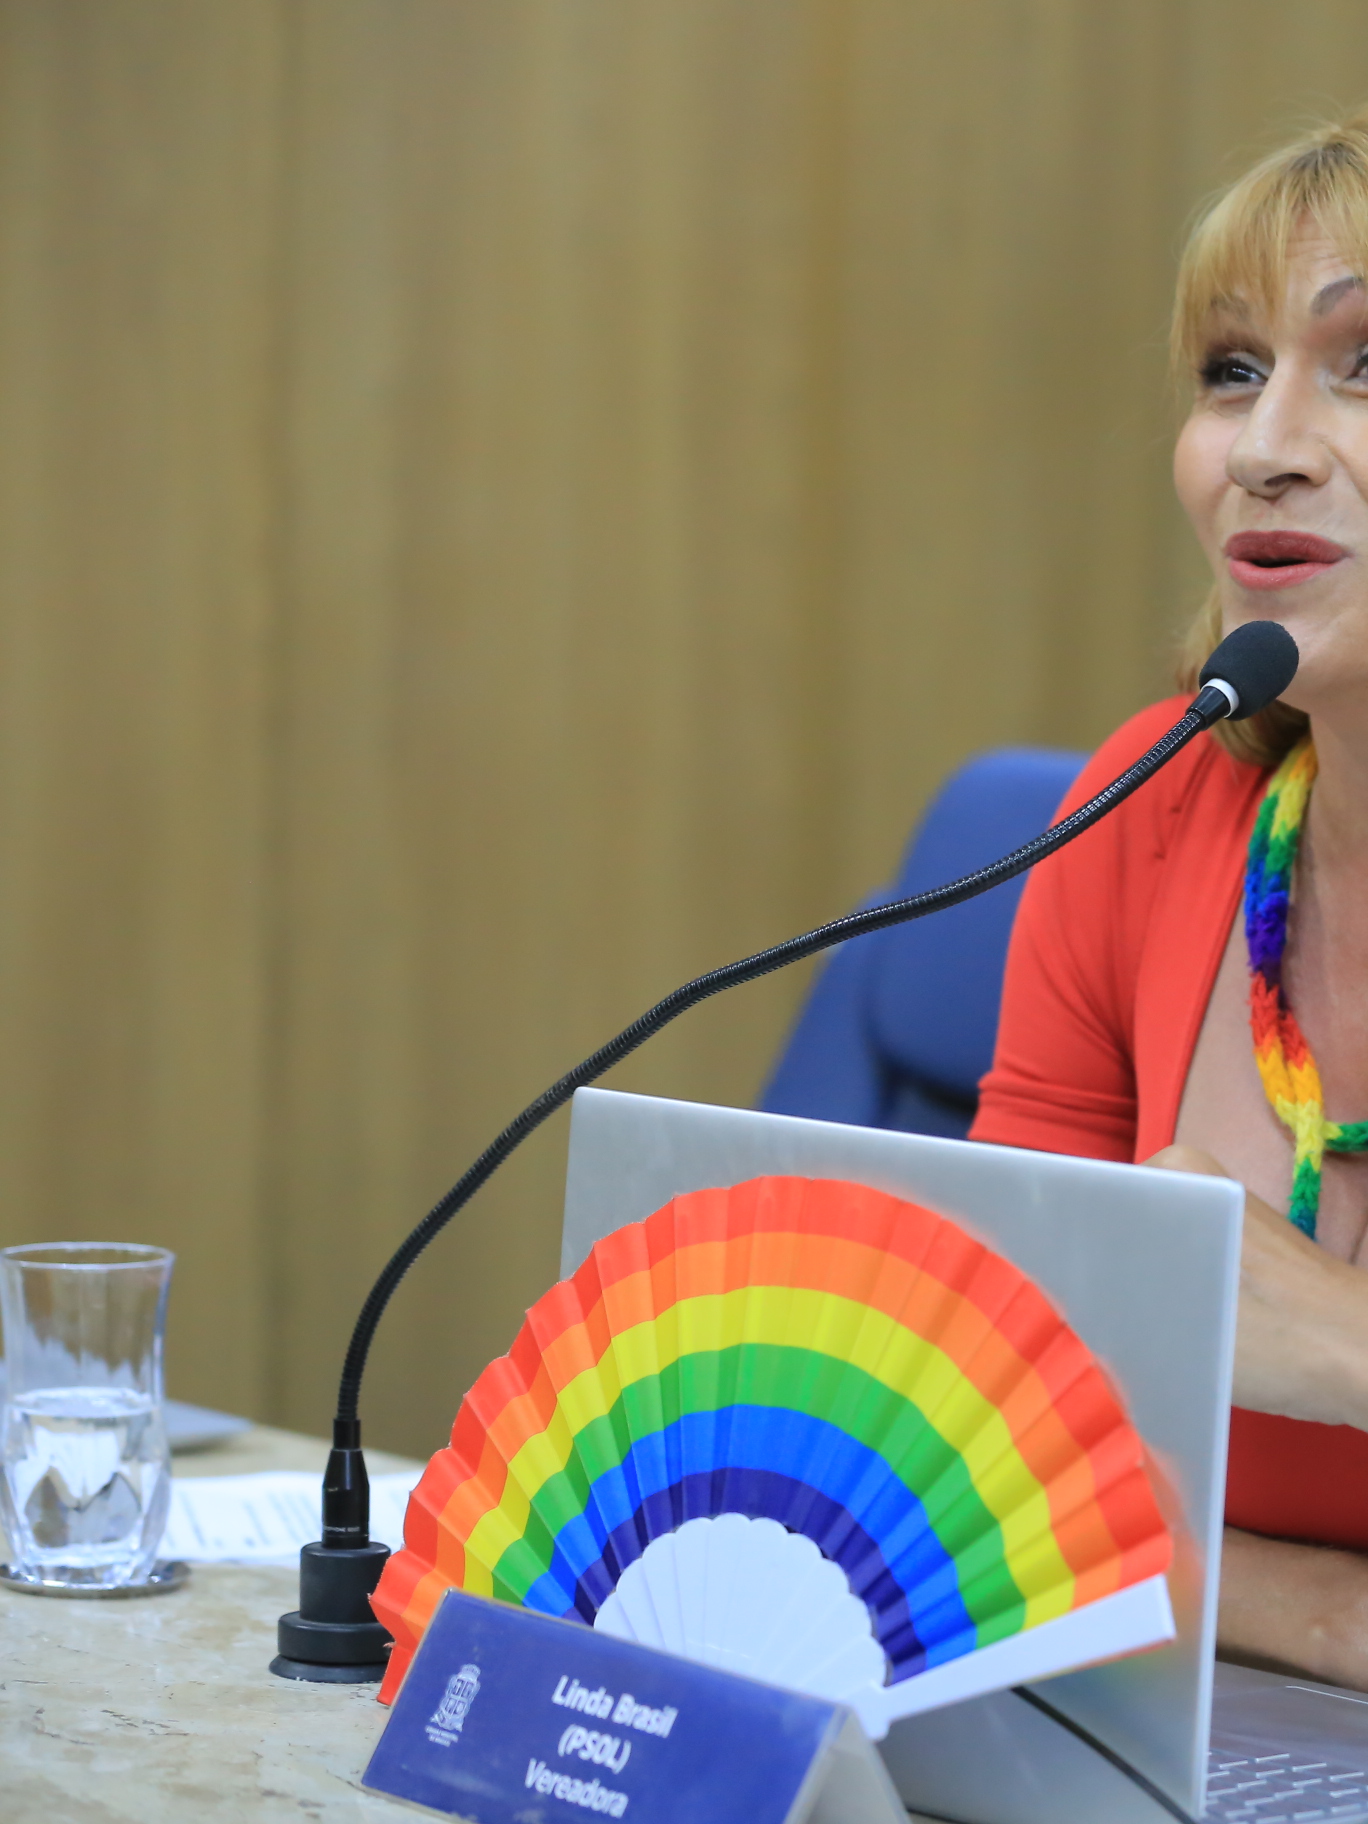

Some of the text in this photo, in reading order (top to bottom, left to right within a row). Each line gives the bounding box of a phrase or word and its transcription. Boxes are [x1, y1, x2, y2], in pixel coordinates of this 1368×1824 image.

[552, 1675, 678, 1738] Linda Brasil
[558, 1724, 631, 1774] (PSOL)
[525, 1758, 629, 1818] Vereadora
